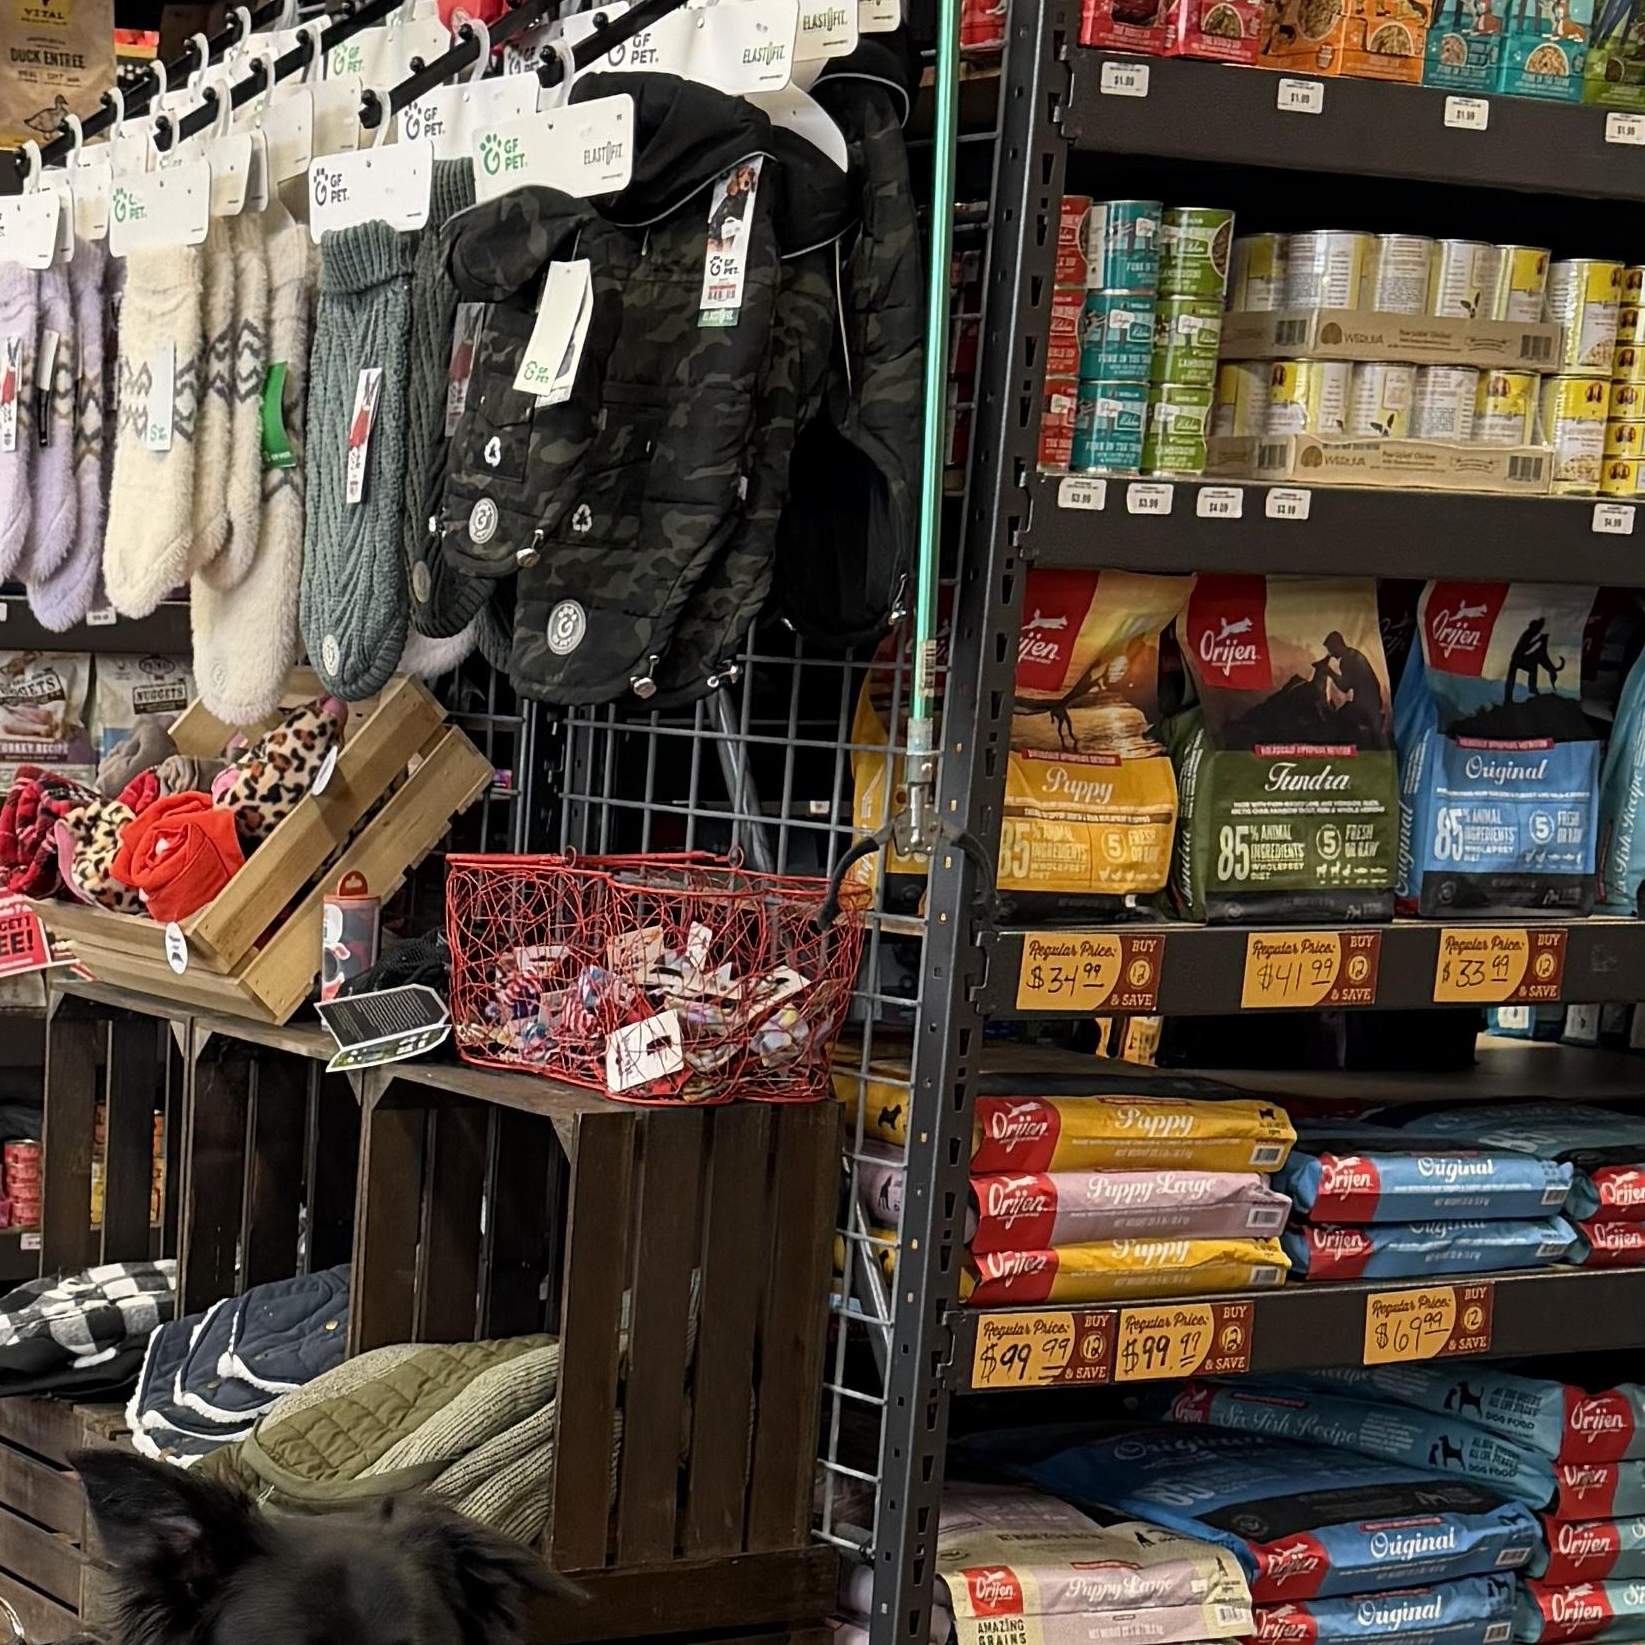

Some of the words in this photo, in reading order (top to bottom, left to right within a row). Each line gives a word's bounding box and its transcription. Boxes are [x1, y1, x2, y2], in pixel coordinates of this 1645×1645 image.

[23, 7, 65, 20] VITAL
[632, 33, 651, 48] GF
[9, 47, 42, 65] DUCK
[43, 49, 86, 70] ENTREE
[348, 45, 360, 58] GF
[423, 107, 438, 121] GF
[504, 137, 519, 154] GF
[330, 173, 343, 188] GF
[1432, 608, 1480, 660] Orijen
[1200, 629, 1257, 678] Orijen
[135, 687, 184, 703] NUGGETS
[35, 740, 69, 755] RECIPE
[1264, 762, 1350, 793] Tundra
[1465, 755, 1549, 785] Original
[1042, 768, 1114, 804] Puppy
[1556, 809, 1581, 825] FRESH
[1345, 824, 1374, 840] FRESH
[1434, 806, 1463, 862] 85
[1471, 807, 1503, 825] ANIMAL
[1463, 825, 1517, 844] INGREDIENTS
[1217, 824, 1249, 882] 85
[1260, 824, 1292, 842] ANIMAL
[1250, 843, 1304, 860] INGREDIENTS
[1345, 842, 1359, 858] OR
[1359, 842, 1379, 858] RAW
[1250, 861, 1304, 872] WHOLEPREY
[1250, 871, 1271, 881] DIET
[1131, 939, 1158, 953] BUY
[1252, 938, 1299, 960] Regular
[1300, 938, 1336, 956] Price:
[1349, 935, 1375, 949] BUY
[1444, 934, 1489, 956] Regular
[1490, 935, 1525, 951] Price:
[1537, 933, 1561, 946] BUY
[1028, 939, 1080, 961] Regular
[1080, 939, 1117, 959] Price:
[1110, 993, 1121, 1007] &
[1121, 993, 1153, 1007] SAVE
[1330, 988, 1340, 1001] &
[1341, 988, 1372, 1001] SAVE
[1518, 986, 1528, 997] &
[1528, 985, 1559, 997] SAVE
[991, 1111, 1048, 1153] Orijen
[1114, 1108, 1195, 1138] Puppy
[1417, 1158, 1496, 1184] Original
[1086, 1176, 1154, 1205] Puppy
[1155, 1172, 1216, 1201] Large
[1320, 1163, 1371, 1201] Orijen
[988, 1182, 1047, 1230] Orijen
[1593, 1223, 1643, 1257] Orijen
[1462, 1287, 1486, 1301] BUY
[1222, 1306, 1248, 1320] BUY
[1371, 1299, 1417, 1319] Regular
[1417, 1295, 1451, 1312] Price:
[983, 1321, 1031, 1341] Regular
[1032, 1316, 1071, 1336] Price:
[1083, 1315, 1110, 1328] BUY
[1124, 1312, 1172, 1333] Regular
[1172, 1309, 1210, 1328] Price:
[1448, 1338, 1457, 1350] &
[1457, 1335, 1488, 1350] SAVE
[1064, 1367, 1075, 1379] &
[1075, 1364, 1108, 1379] SAVE
[1204, 1359, 1215, 1371] &
[1216, 1356, 1246, 1371] SAVE
[1485, 1411, 1506, 1424] DOG
[1506, 1416, 1535, 1430] FOOD
[1570, 1401, 1627, 1444] Orijen
[1468, 1464, 1487, 1474] DOG
[1489, 1466, 1518, 1478] FOOD
[1369, 1526, 1457, 1562] Original
[1558, 1523, 1611, 1566] Orijen
[975, 1576, 1013, 1608] Orijen
[1065, 1577, 1124, 1602] Puppy
[1123, 1573, 1173, 1596] Large
[1357, 1595, 1443, 1631] Original
[1552, 1594, 1603, 1634] Orijen
[977, 1619, 1025, 1634] AMAZING
